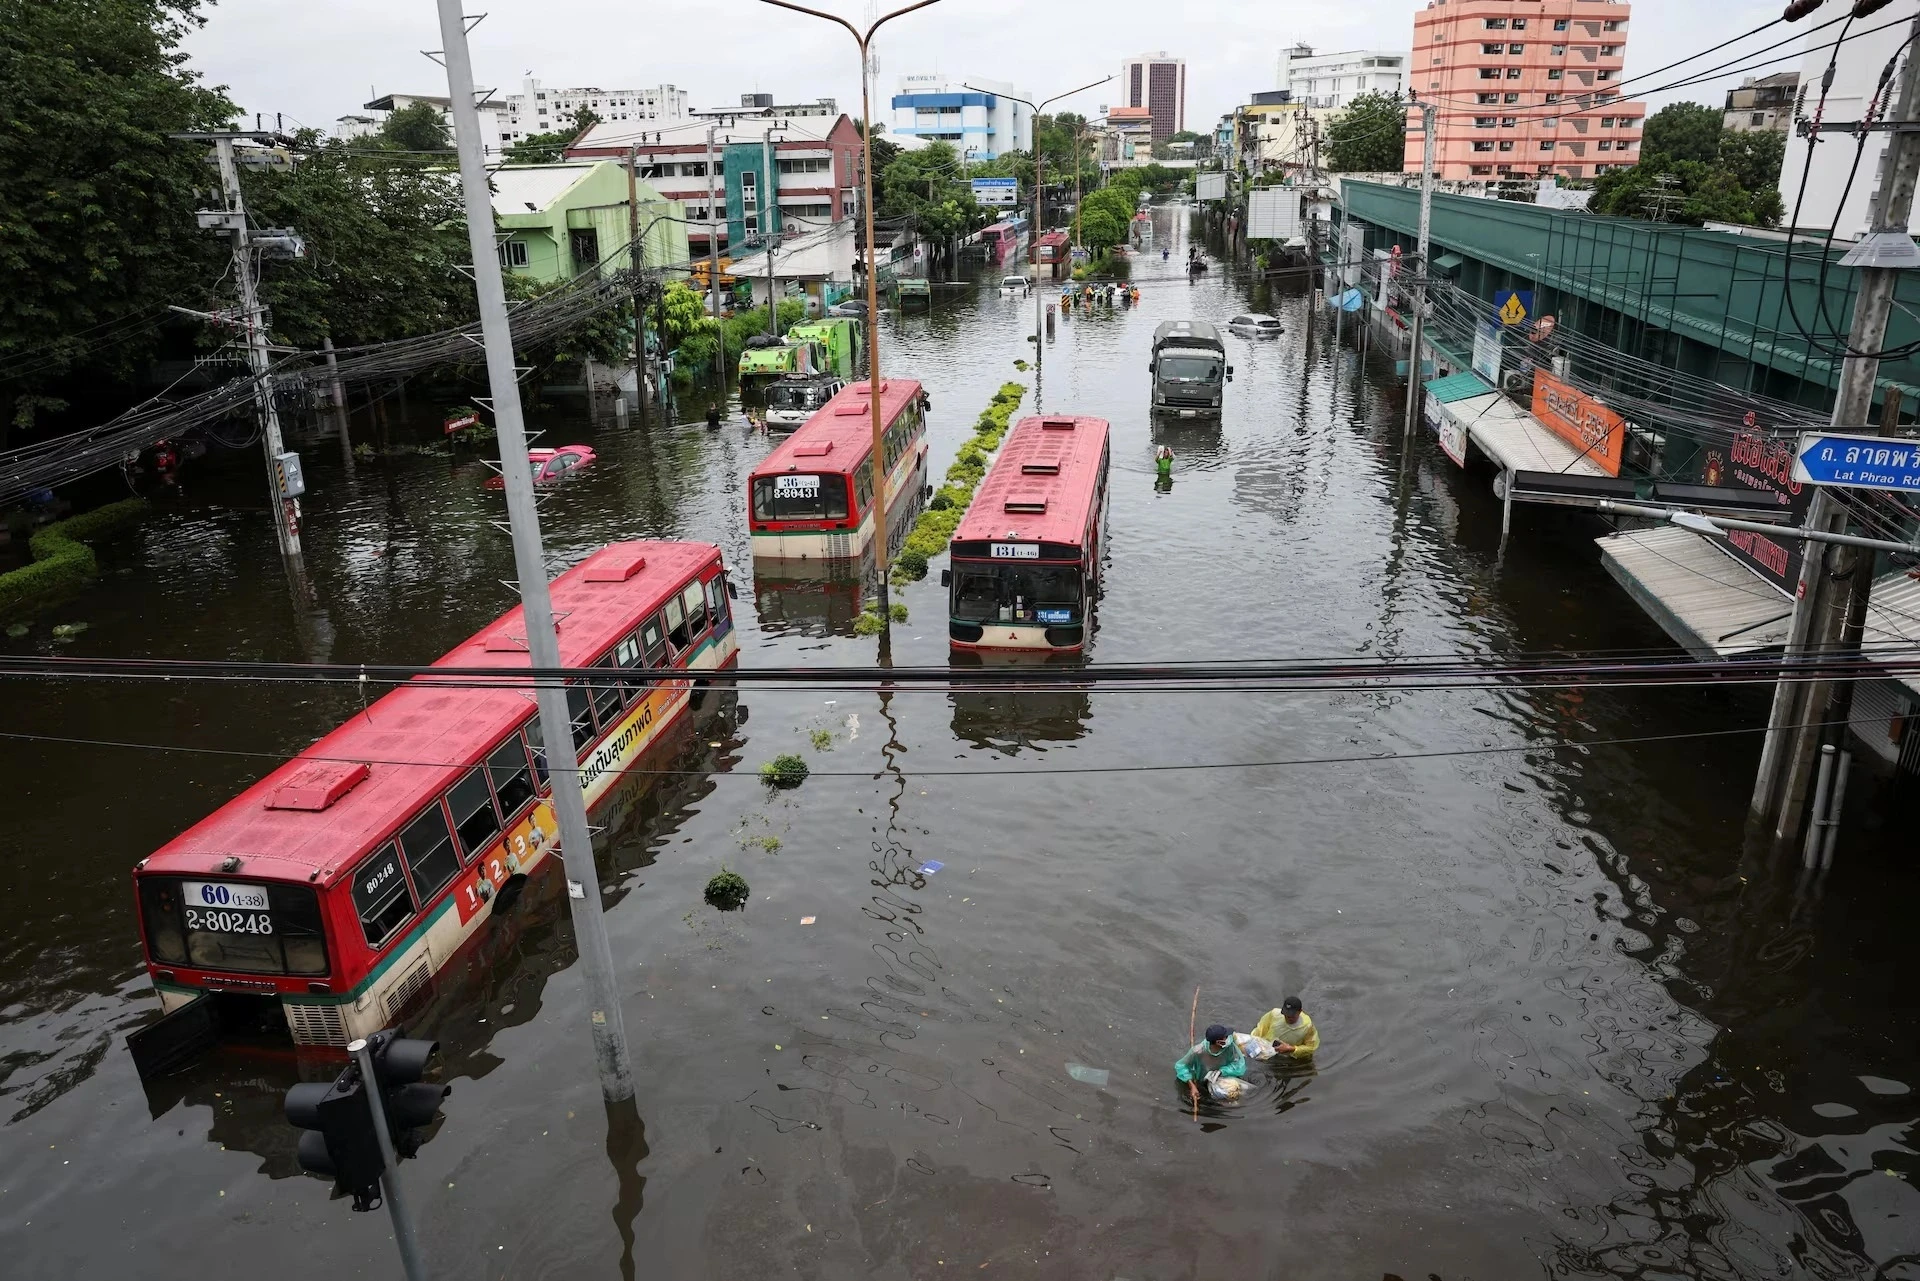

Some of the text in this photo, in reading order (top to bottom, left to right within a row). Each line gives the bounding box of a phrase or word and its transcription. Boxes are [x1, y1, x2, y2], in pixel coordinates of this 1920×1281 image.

[1821, 447, 1837, 462] ถ.
[783, 477, 798, 488] 36
[1834, 469, 1854, 480] Lat
[1860, 471, 1895, 484] Phrao
[773, 487, 819, 499] 8-80431
[996, 546, 1015, 557] 131
[580, 703, 653, 789] บแต้มสุขภาพดี
[515, 834, 527, 855] 3
[366, 862, 394, 895] 80248
[490, 859, 503, 880] 2
[201, 884, 264, 908] 60 (1-38)
[465, 884, 477, 903] 1
[185, 909, 273, 935] 2-80248
